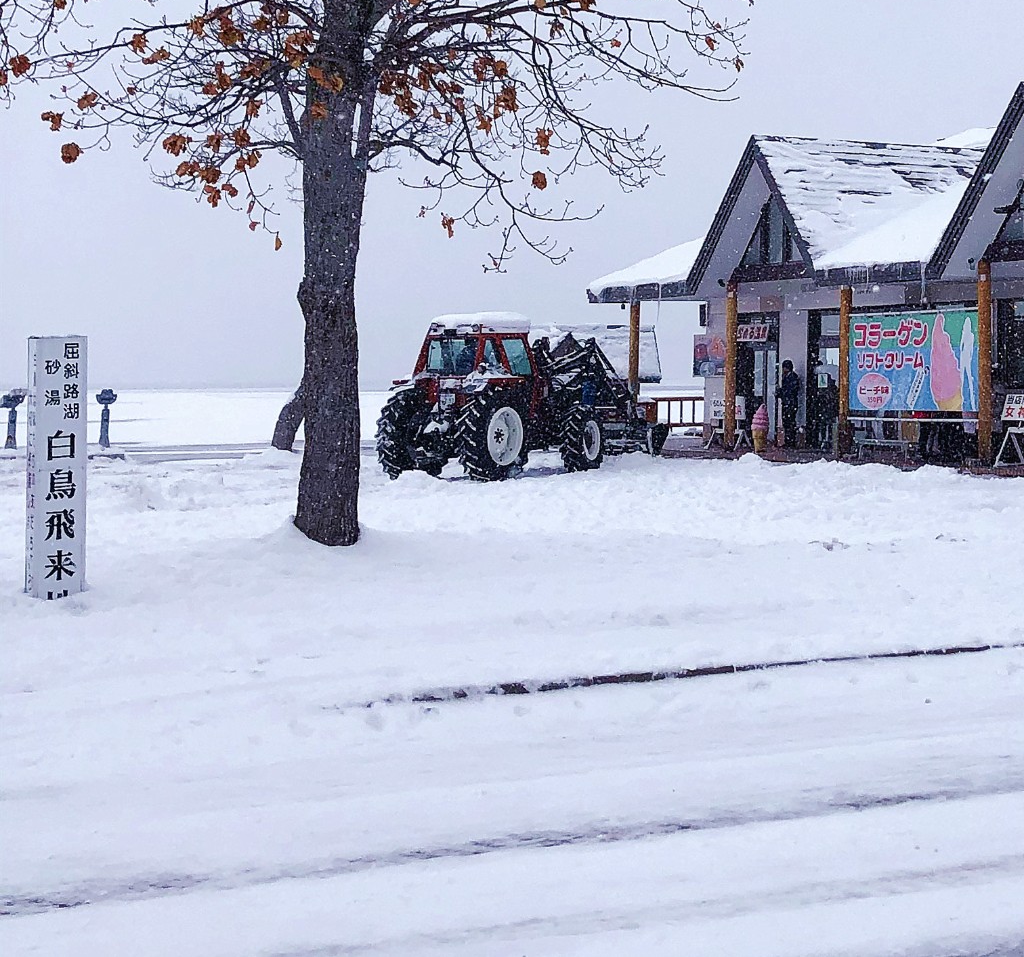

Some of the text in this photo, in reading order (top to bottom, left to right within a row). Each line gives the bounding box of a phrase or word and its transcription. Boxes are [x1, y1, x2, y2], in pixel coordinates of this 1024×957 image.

[854, 319, 928, 347] コラーゲン
[857, 351, 924, 370] ソフトクリーム
[44, 358, 62, 407] 砂湯
[63, 342, 80, 420] 屈斜路湖
